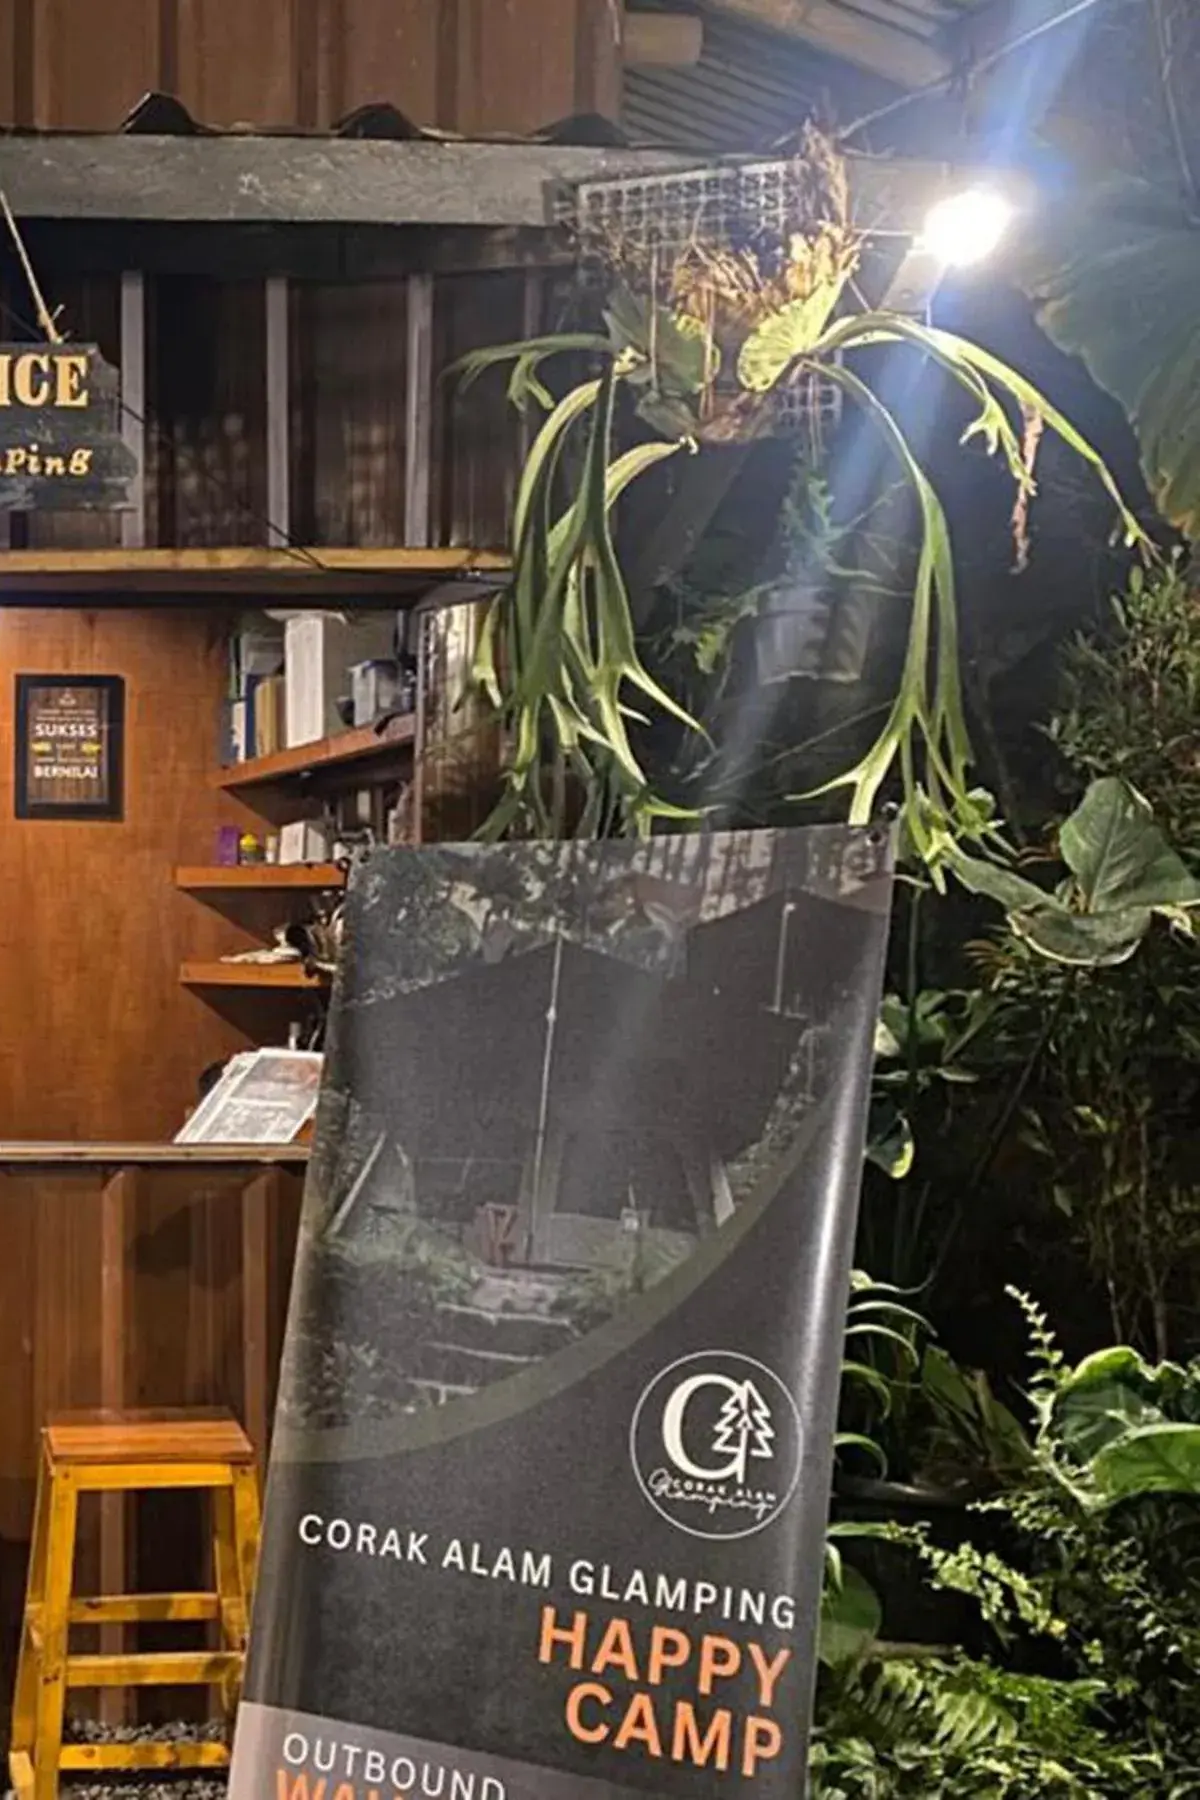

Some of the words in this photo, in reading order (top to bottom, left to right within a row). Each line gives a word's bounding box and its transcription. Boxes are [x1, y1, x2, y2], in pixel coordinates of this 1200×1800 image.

[299, 1514, 429, 1564] CORAK
[441, 1538, 552, 1588] ALAM
[568, 1558, 796, 1629] GLAMPING
[538, 1604, 792, 1708] HAPPY
[282, 1732, 506, 1800] OUTBOUND
[565, 1683, 784, 1778] CAMP
